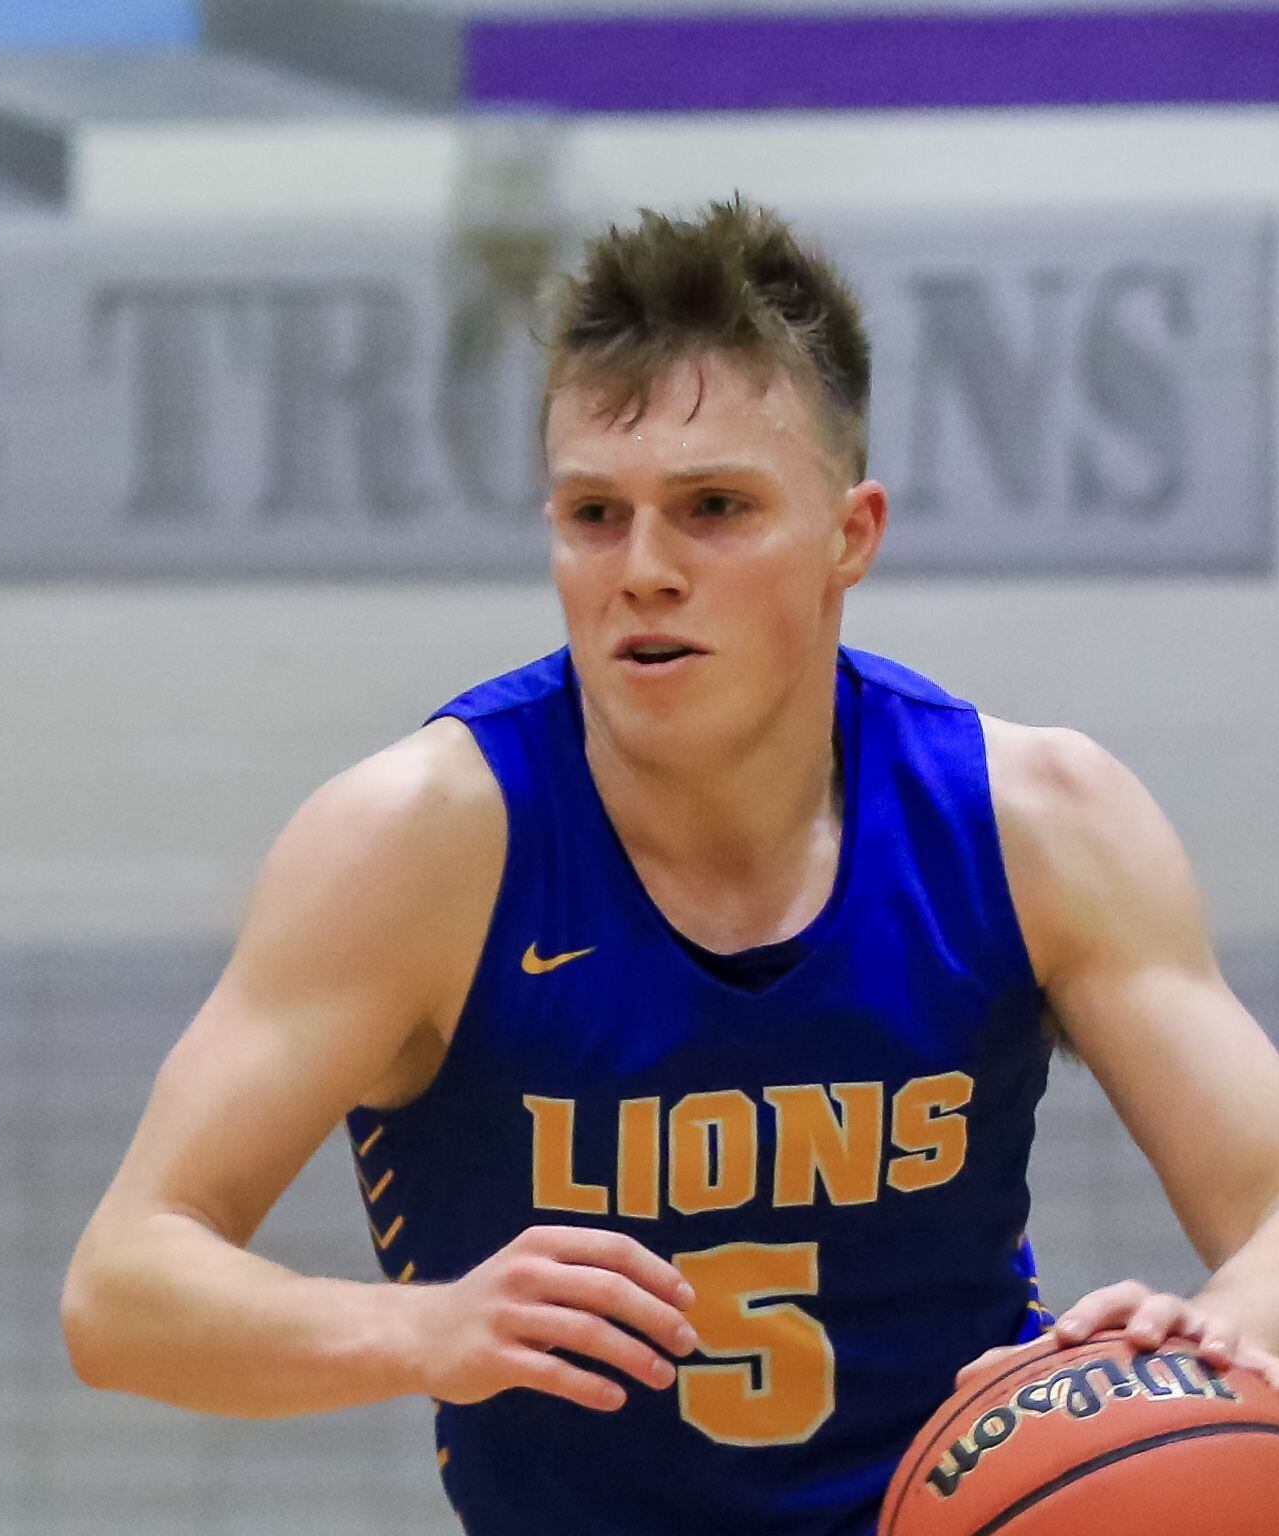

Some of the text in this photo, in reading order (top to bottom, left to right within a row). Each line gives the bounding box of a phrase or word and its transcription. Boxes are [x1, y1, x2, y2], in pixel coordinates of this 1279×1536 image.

[84, 262, 1200, 527] TRONS
[522, 1070, 975, 1220] LIONS
[671, 1241, 836, 1448] 5
[925, 1350, 1242, 1502] Wilson
